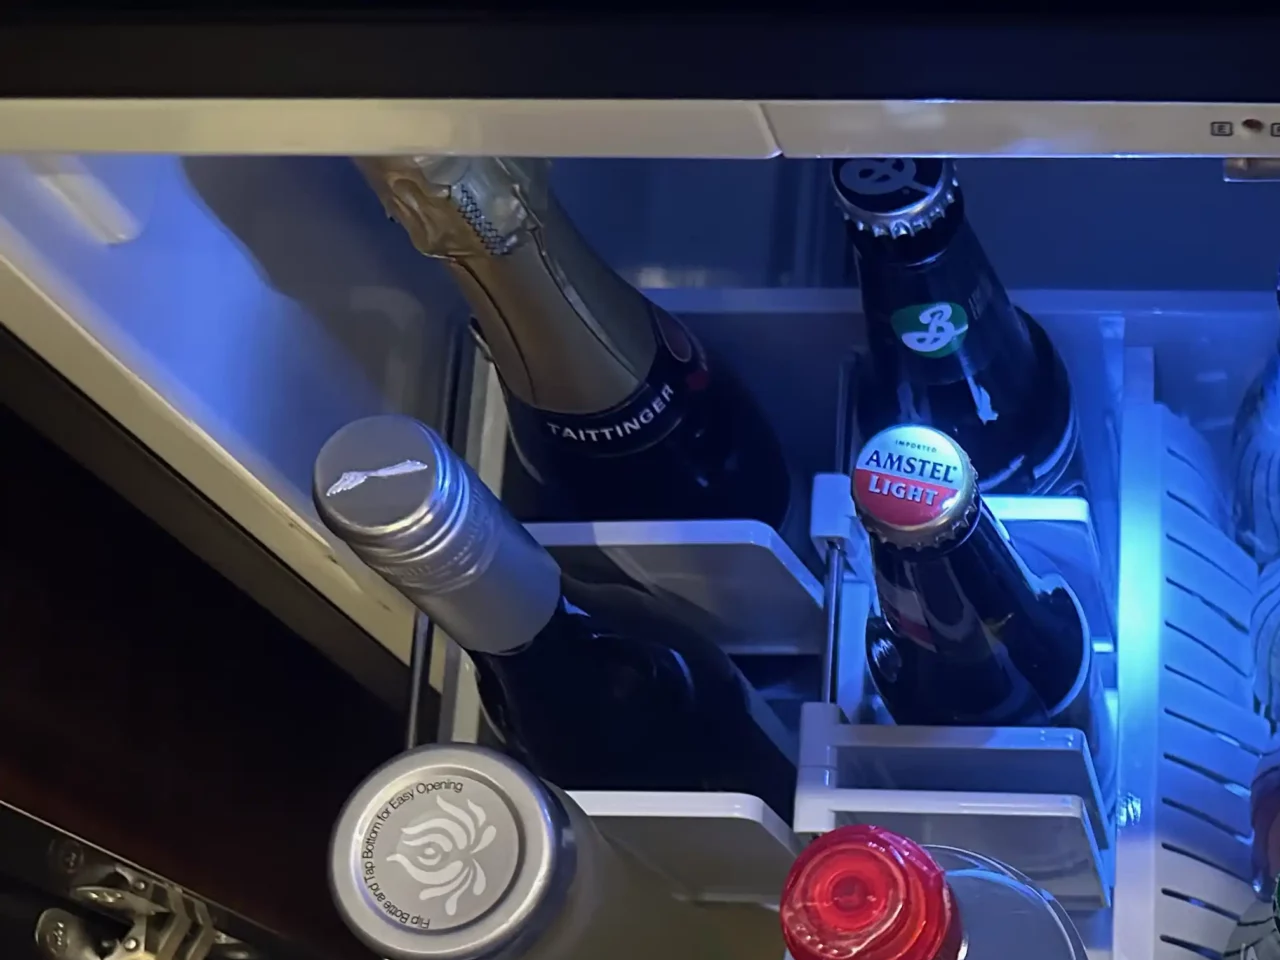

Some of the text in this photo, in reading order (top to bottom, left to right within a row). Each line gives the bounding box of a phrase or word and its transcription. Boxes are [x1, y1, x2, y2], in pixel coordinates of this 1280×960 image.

[546, 383, 674, 442] TAITTINGER
[895, 439, 938, 454] IMPORTED
[865, 449, 955, 484] AMSTEL
[868, 473, 939, 506] LIGHT
[362, 778, 464, 930] Flip Bottle and Tap Bottom for Easy Opening
